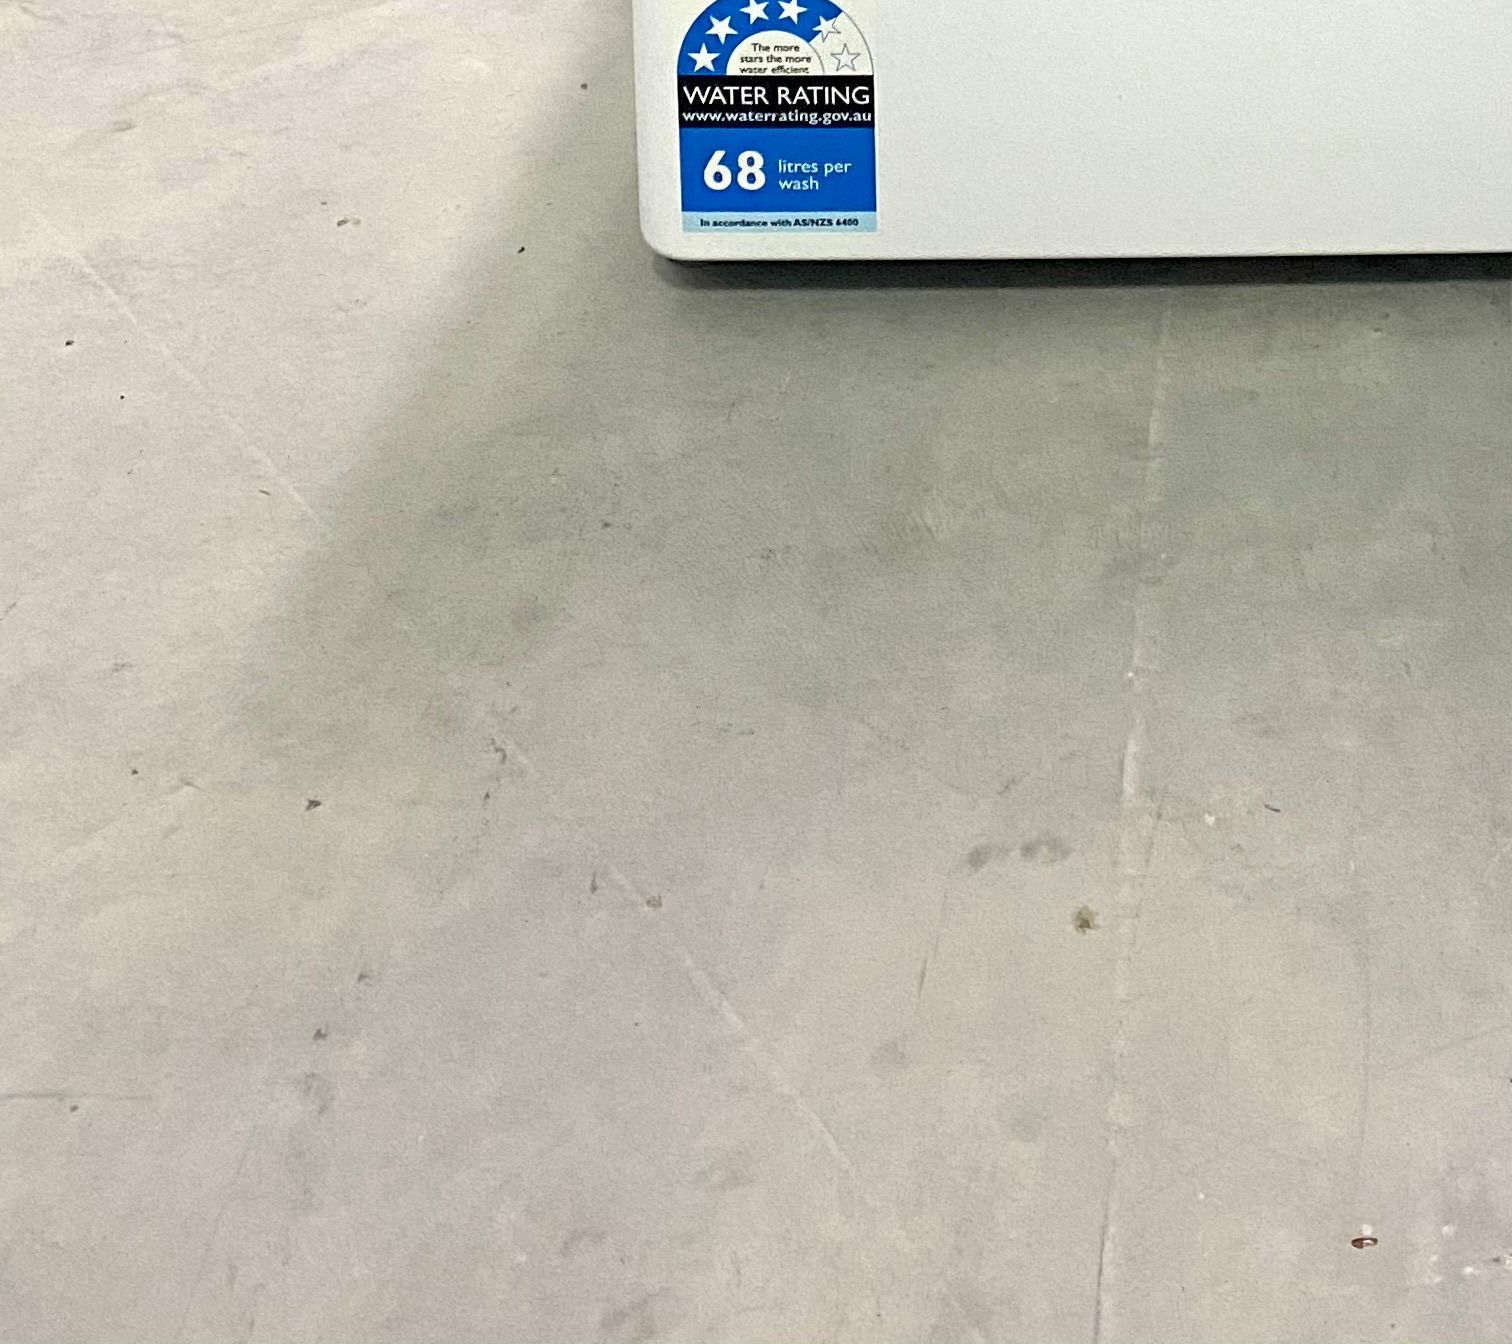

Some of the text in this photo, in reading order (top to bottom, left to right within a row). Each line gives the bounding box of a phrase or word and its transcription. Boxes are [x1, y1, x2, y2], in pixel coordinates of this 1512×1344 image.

[751, 42, 770, 52] The
[766, 54, 783, 63] the
[771, 65, 810, 74] efficient
[682, 86, 870, 105] WATER RATING
[682, 110, 872, 125] www.waterrating.gov.au
[703, 150, 766, 191] 68
[778, 159, 852, 177] litres per
[778, 176, 819, 191] wash
[700, 218, 860, 227] In accordance with AS/NZS 6400
